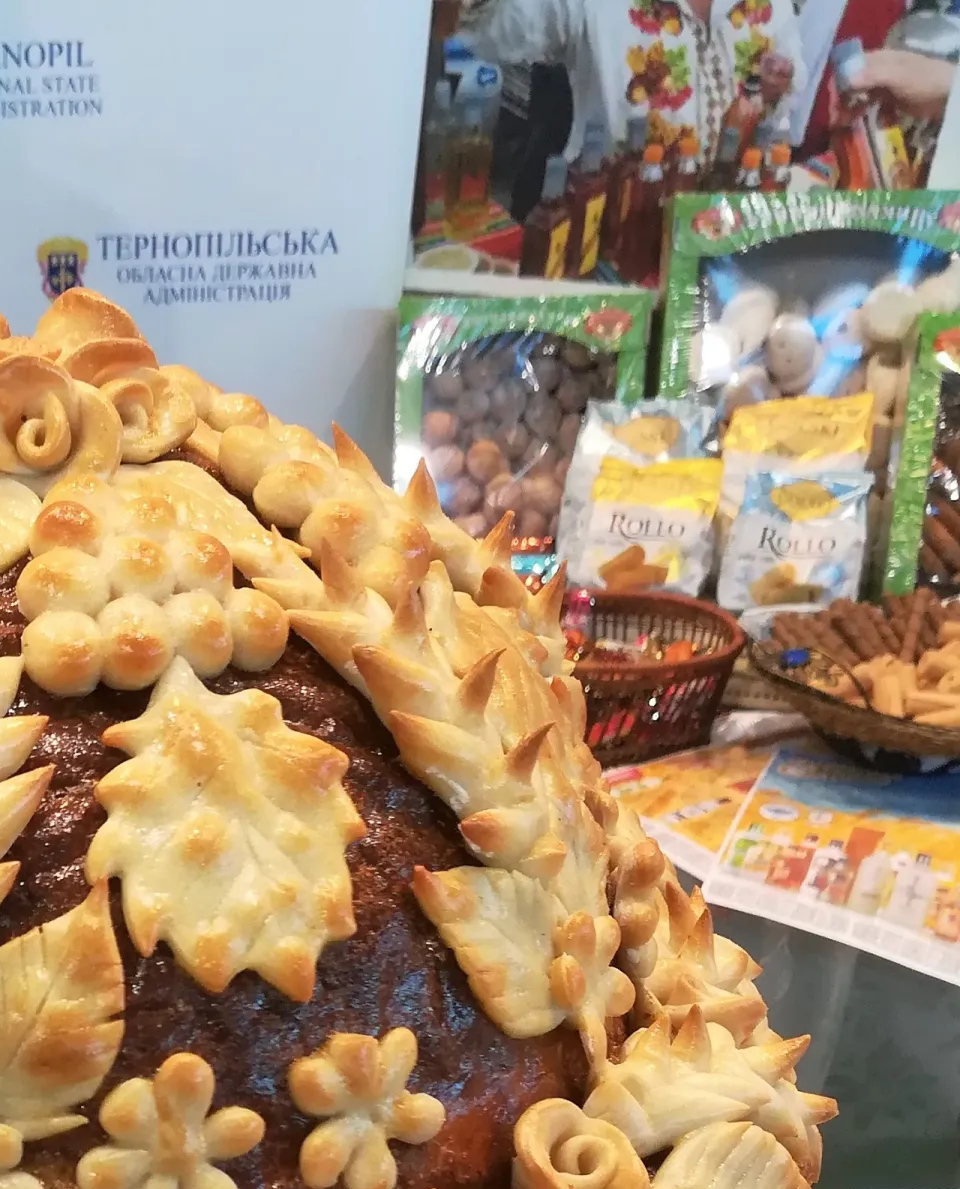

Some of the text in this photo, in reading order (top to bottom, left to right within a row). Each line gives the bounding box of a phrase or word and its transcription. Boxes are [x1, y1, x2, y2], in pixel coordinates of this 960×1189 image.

[42, 74, 100, 95] STATE
[96, 228, 339, 261] ТЕРНОПІЛЬСЬКА
[116, 262, 318, 284] ОБЛАСНА ДЕРЖАВНА
